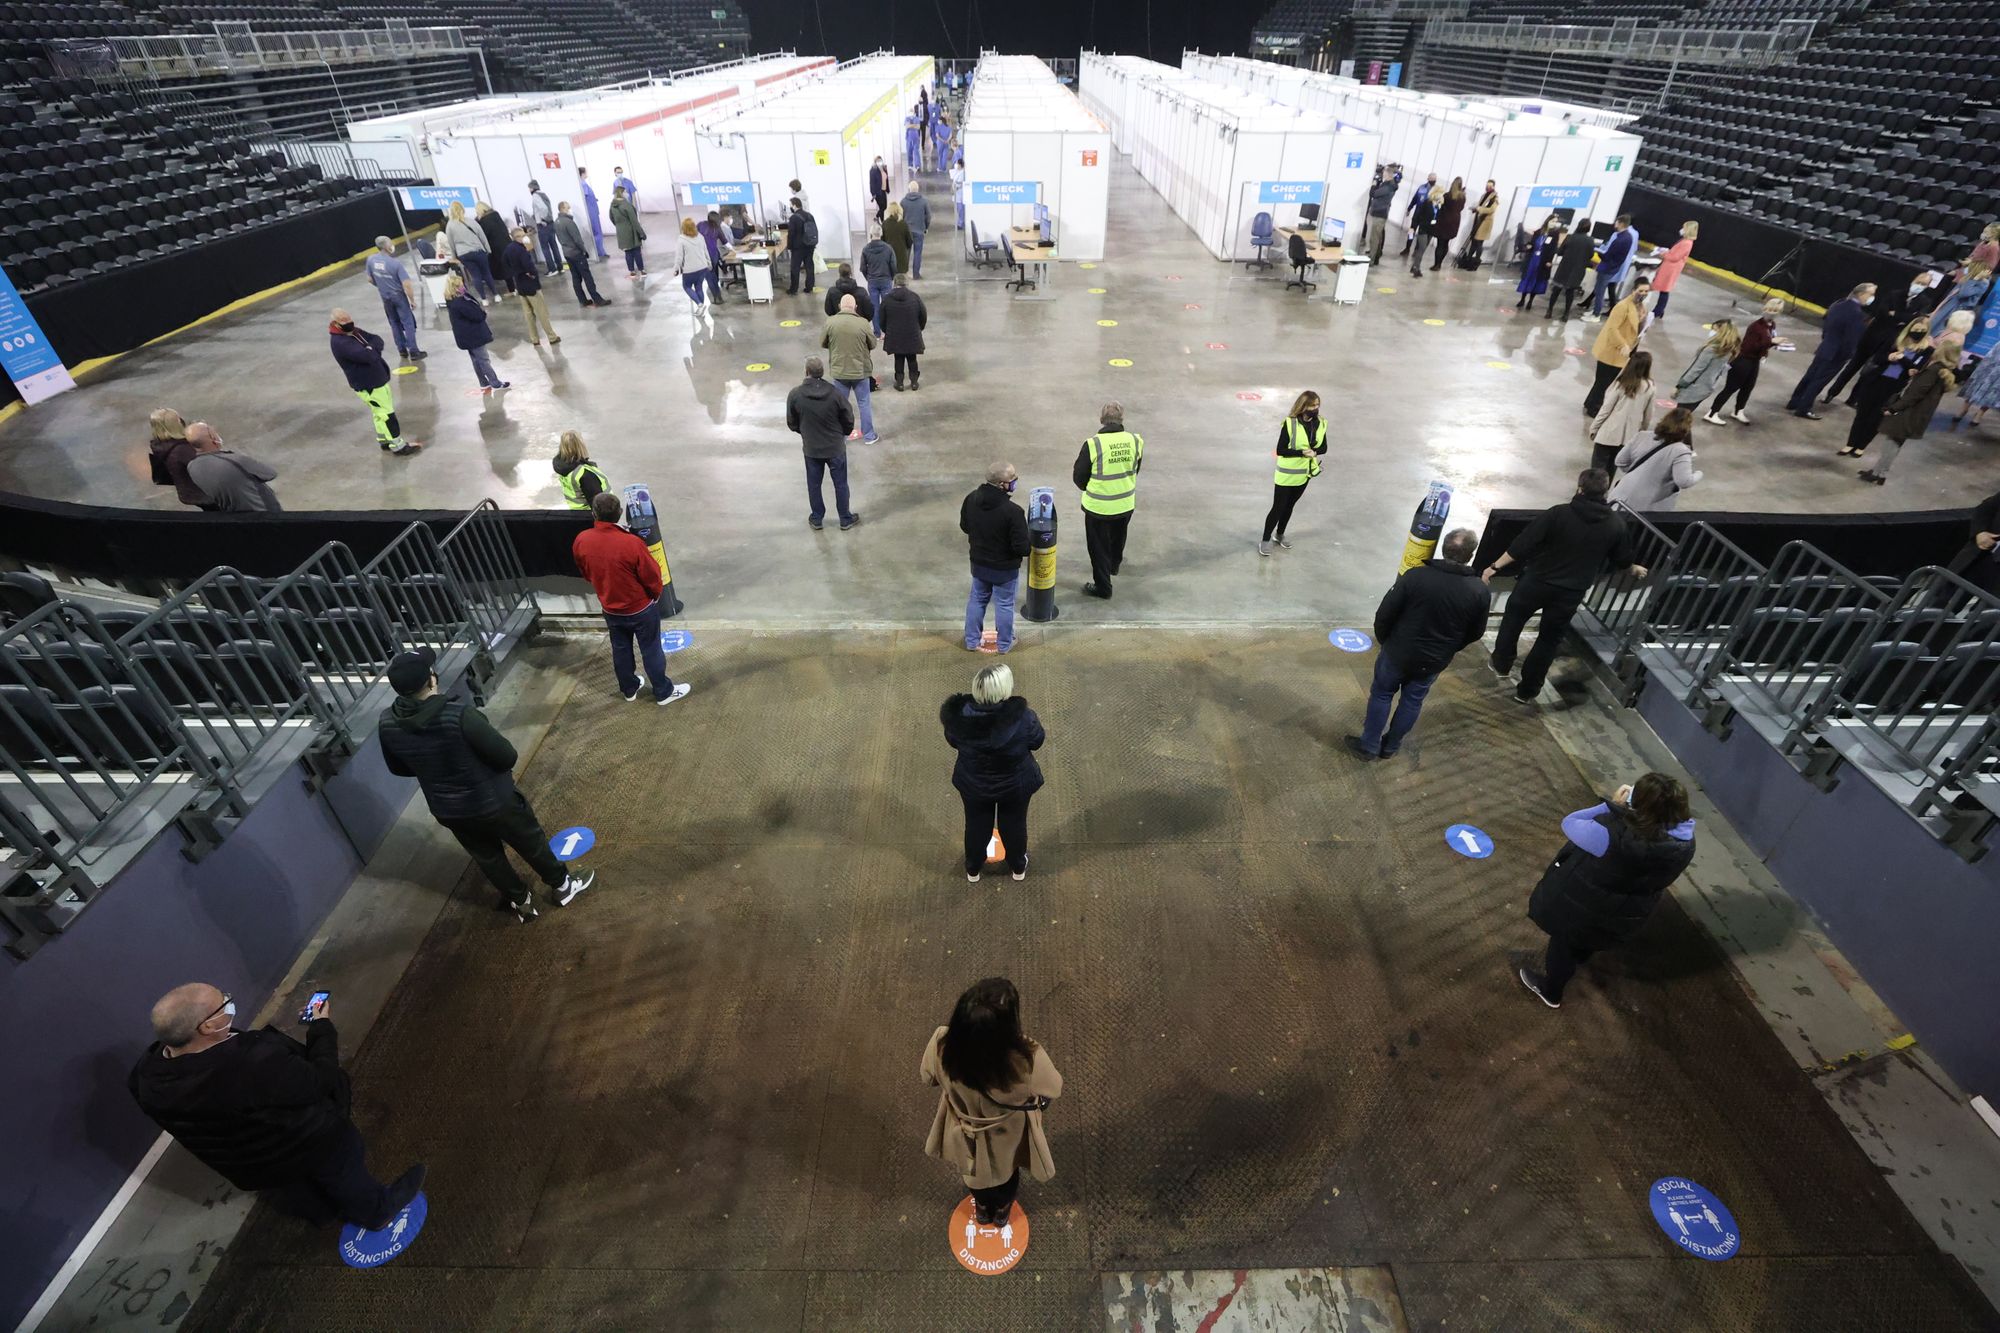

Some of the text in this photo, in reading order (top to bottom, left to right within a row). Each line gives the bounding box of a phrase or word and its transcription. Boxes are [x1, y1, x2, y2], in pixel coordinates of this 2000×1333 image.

[701, 185, 742, 194] CHECK
[983, 184, 1024, 193] CHECK
[1271, 184, 1311, 192] CHECK
[420, 190, 461, 198] CHECK
[1284, 193, 1296, 201] IN
[1541, 188, 1581, 198] CHECK
[1552, 198, 1565, 206] IN
[1108, 442, 1132, 450] VACCINE
[1110, 450, 1131, 458] CENTRE
[1658, 1180, 1695, 1194] SOCIAL
[1680, 1232, 1736, 1256] DISTANCING
[344, 1240, 402, 1264] DISTANCING
[960, 1248, 1020, 1270] DISTANCING
